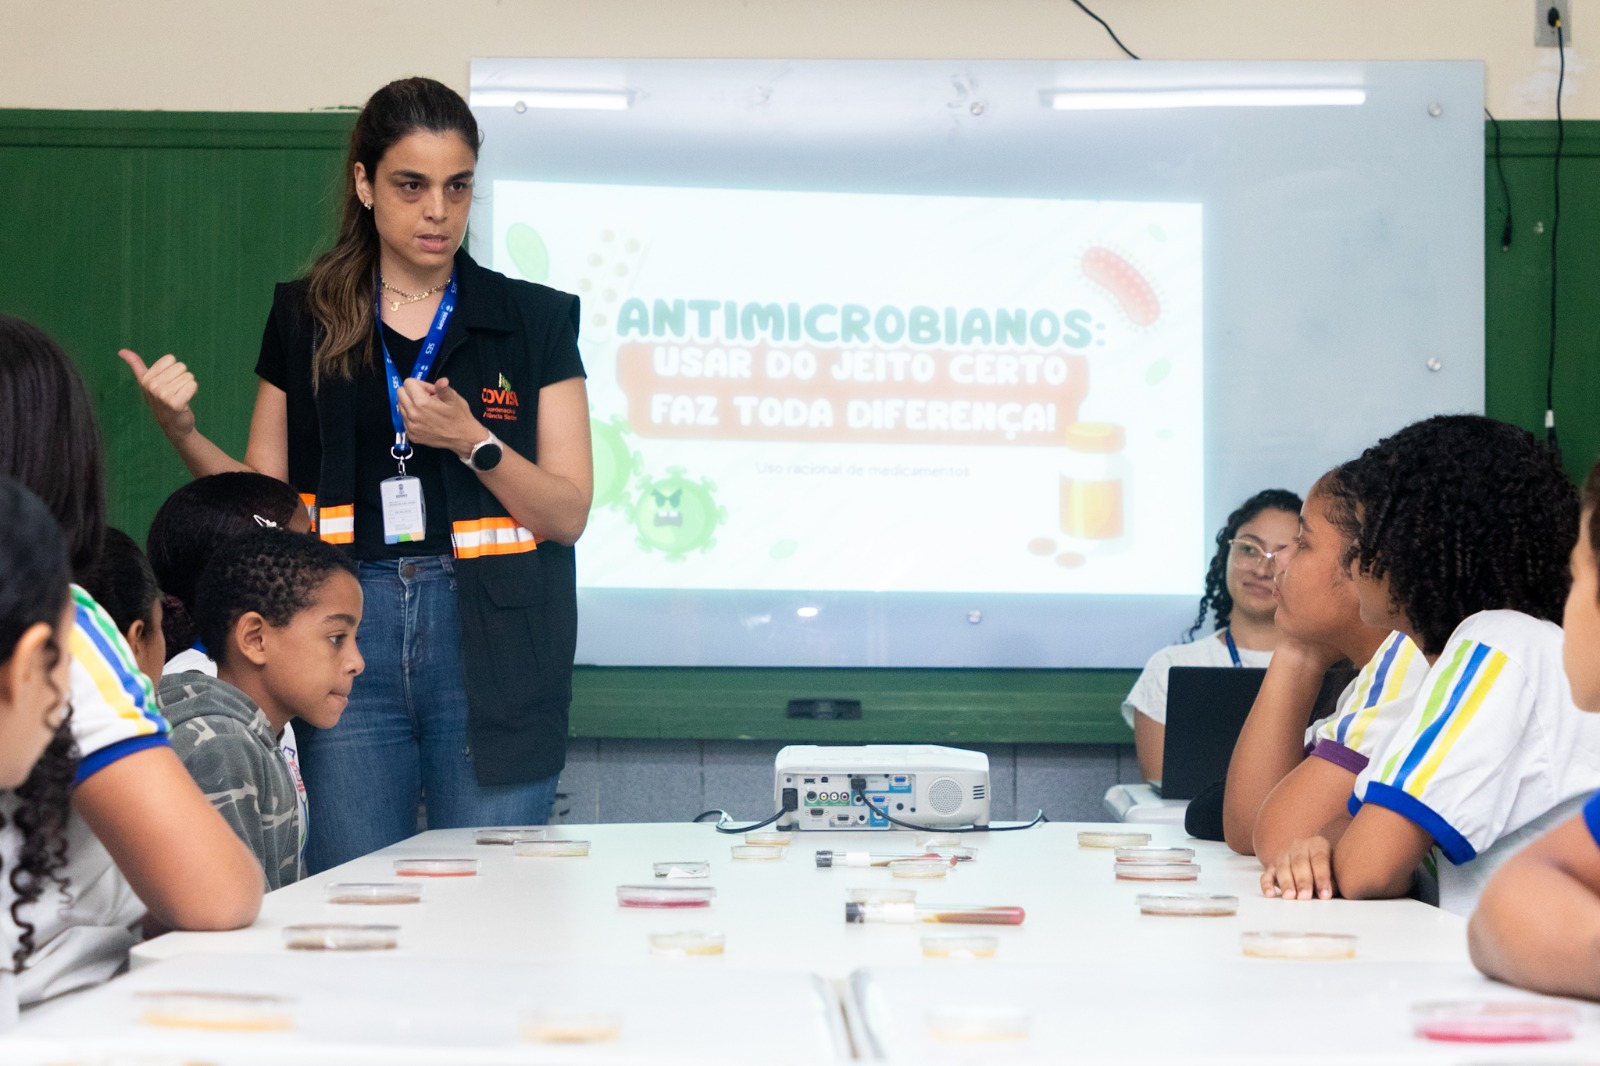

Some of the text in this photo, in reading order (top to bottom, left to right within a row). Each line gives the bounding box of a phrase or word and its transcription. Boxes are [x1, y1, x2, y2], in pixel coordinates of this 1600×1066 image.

[616, 297, 1105, 348] ANTIMICROBIANOS:
[654, 347, 1067, 386] USAR DO JEITO CERTO
[651, 393, 1057, 440] FAZ TODA DIFERENÇA!
[756, 462, 971, 478] Uso racional de medicamentos
